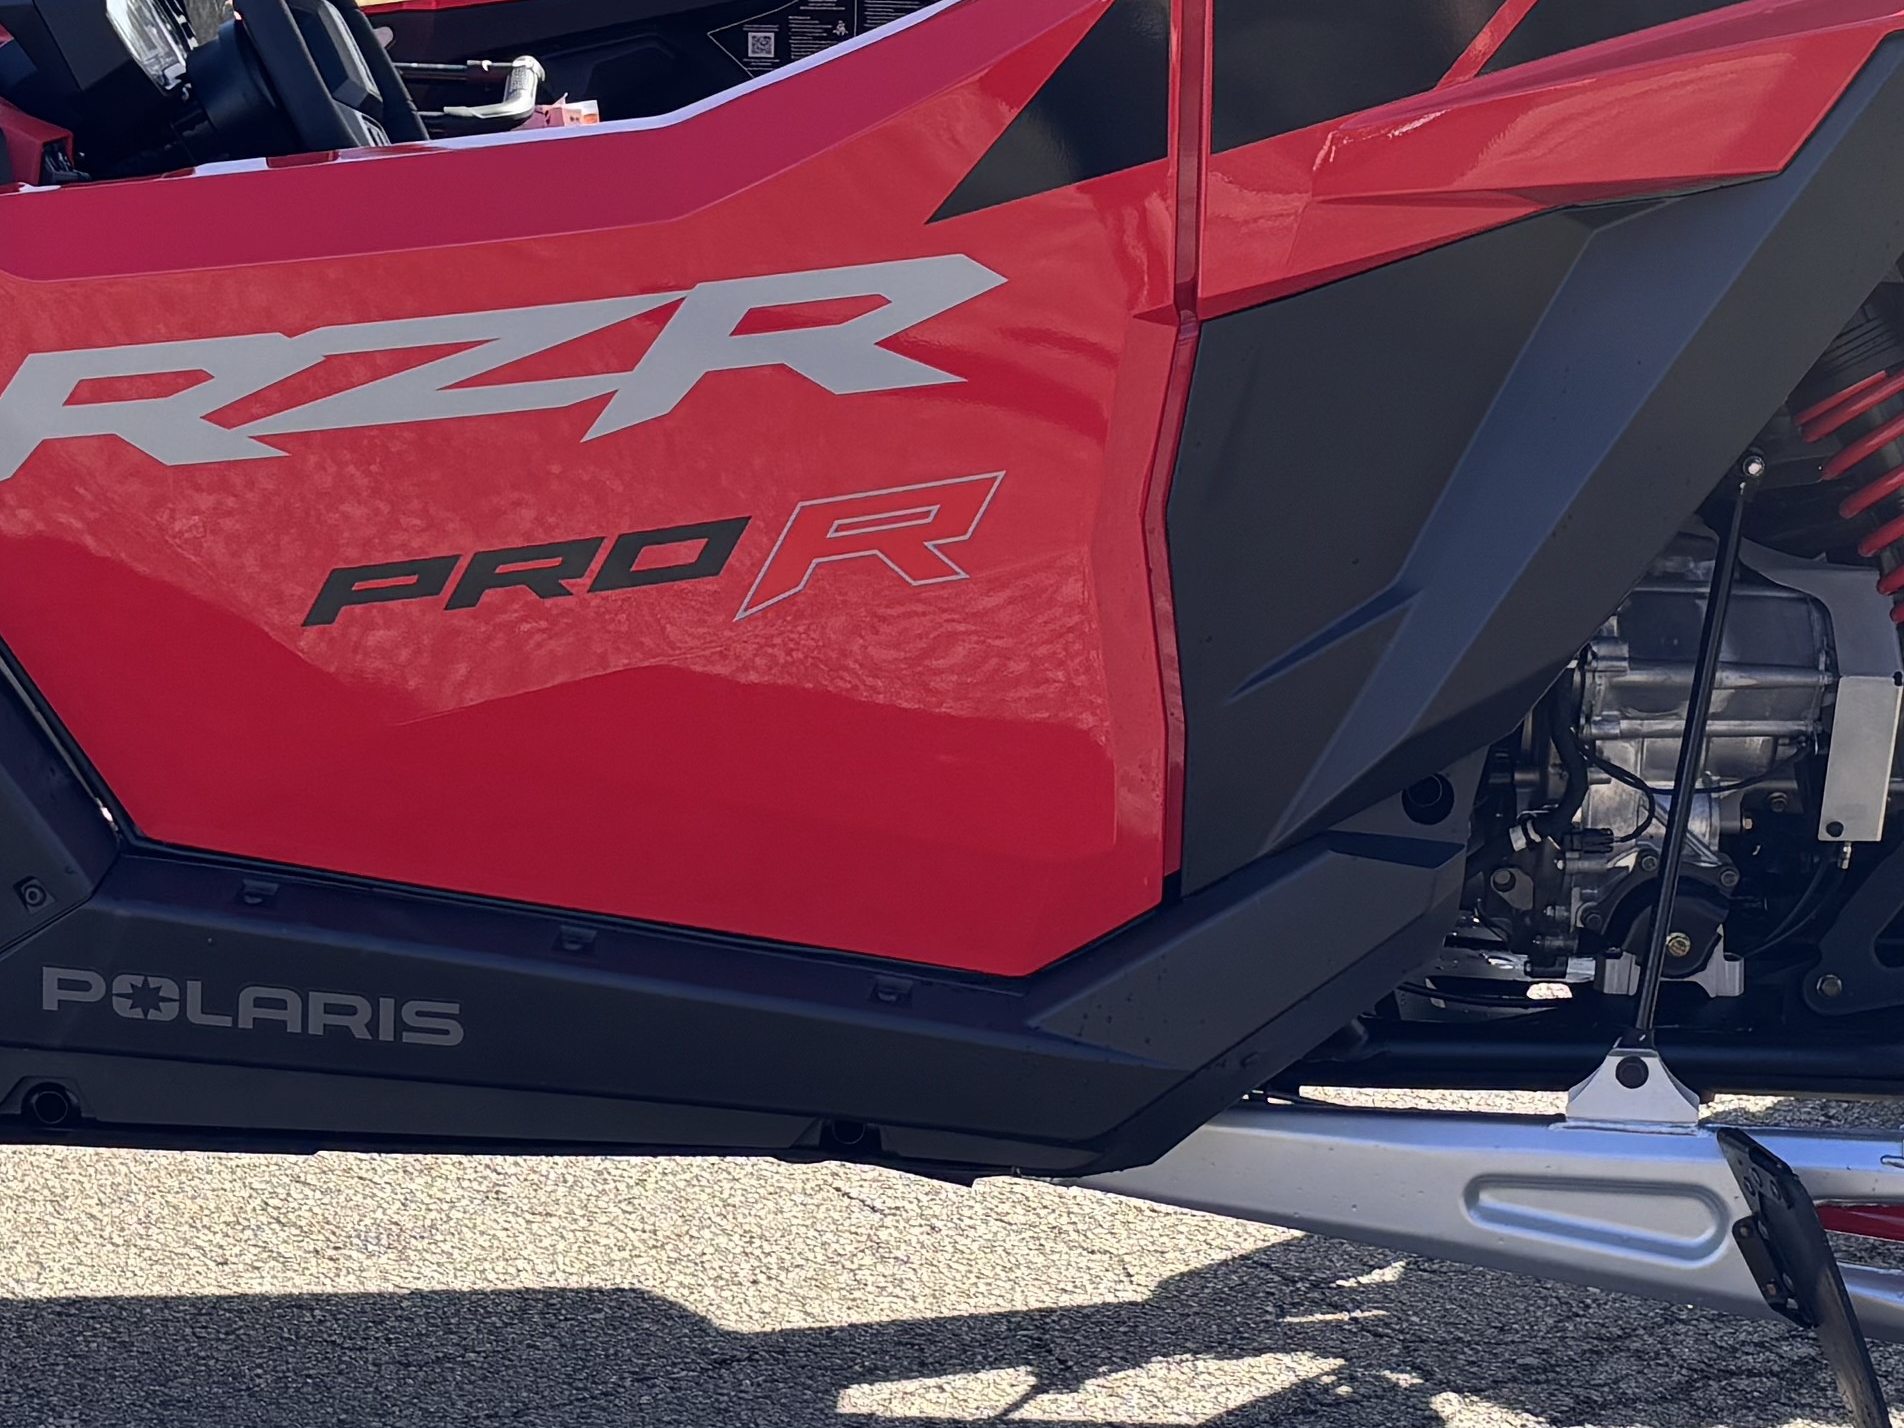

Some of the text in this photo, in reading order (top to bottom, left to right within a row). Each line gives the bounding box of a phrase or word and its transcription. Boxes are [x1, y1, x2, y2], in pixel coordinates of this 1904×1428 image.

[300, 471, 1004, 627] PRO R
[42, 964, 464, 1046] POLARIS
